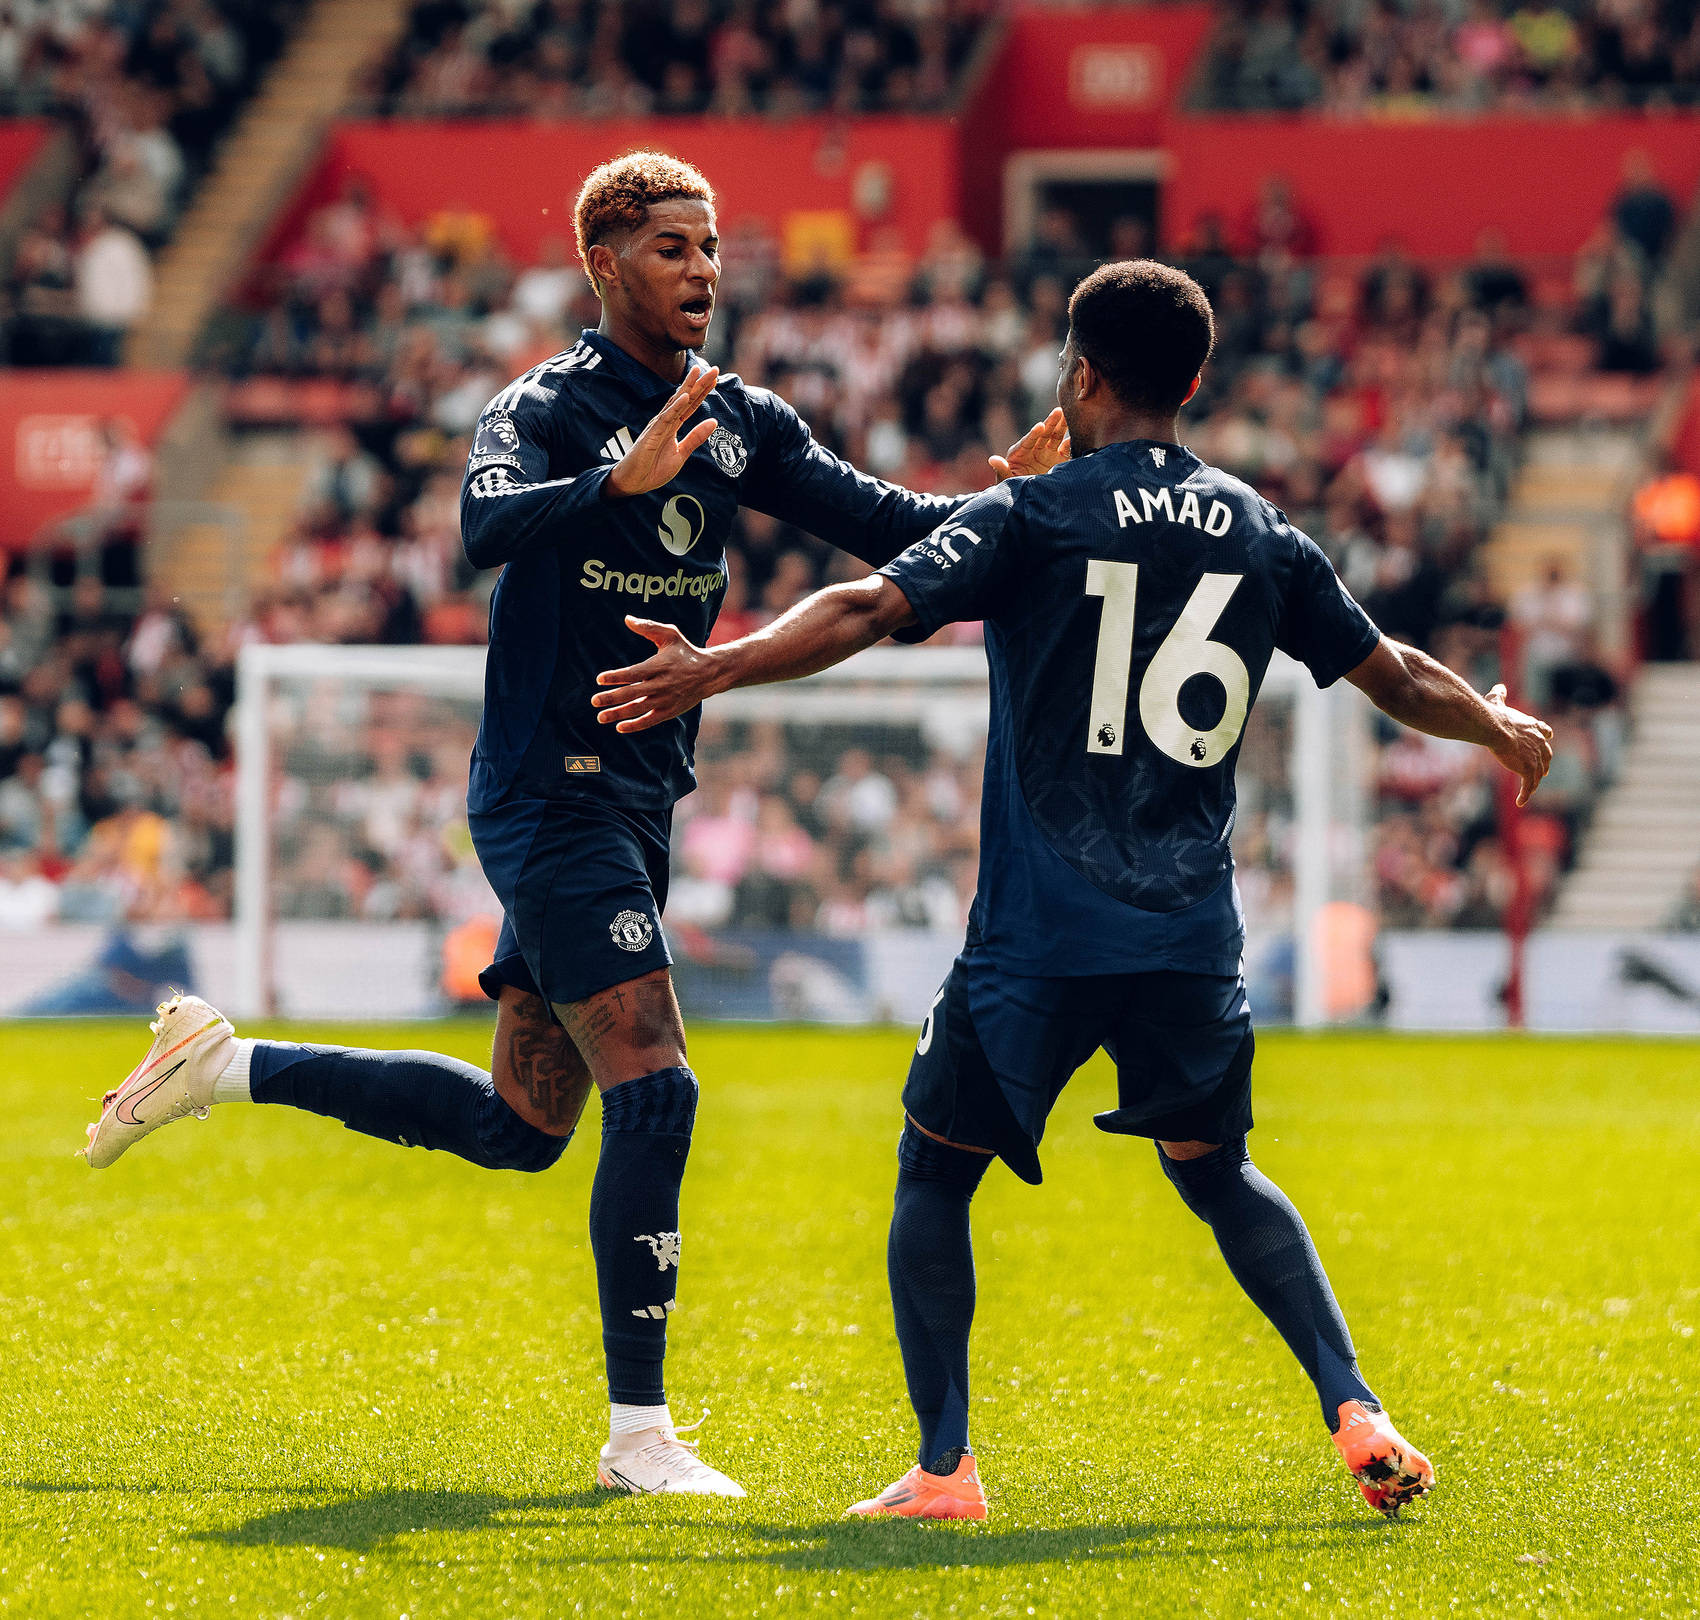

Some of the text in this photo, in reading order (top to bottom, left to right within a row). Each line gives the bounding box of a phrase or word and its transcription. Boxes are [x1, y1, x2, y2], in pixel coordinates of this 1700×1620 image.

[1113, 487, 1234, 538] AMAD
[914, 543, 952, 570] OLOGY
[579, 559, 724, 603] Snapdragon
[1085, 559, 1250, 768] 16
[613, 913, 644, 932] MANCHESTER
[627, 938, 649, 949] UNITED
